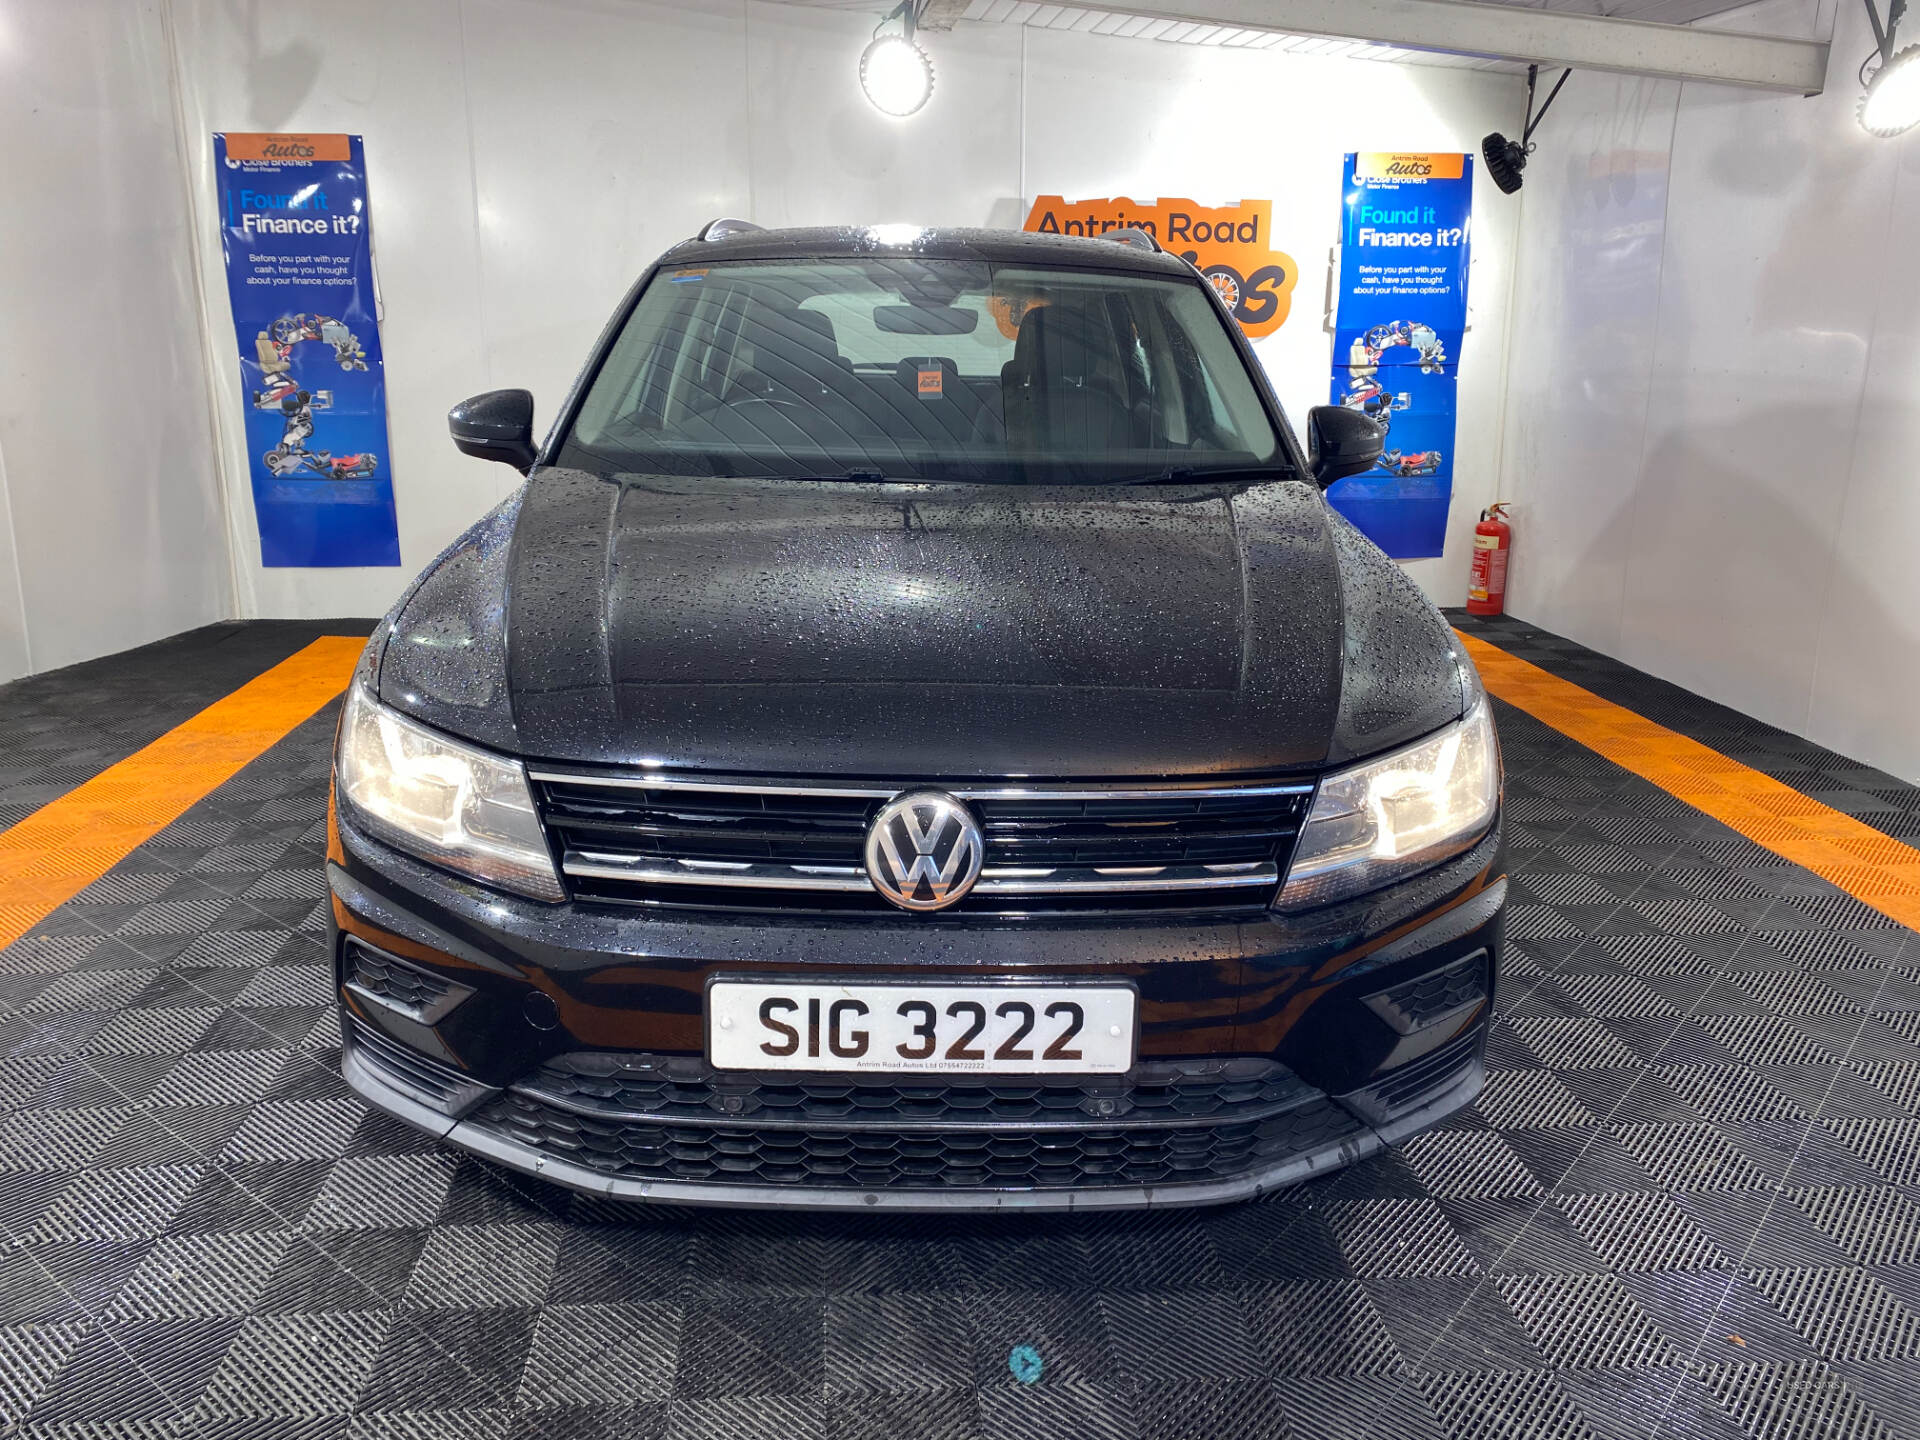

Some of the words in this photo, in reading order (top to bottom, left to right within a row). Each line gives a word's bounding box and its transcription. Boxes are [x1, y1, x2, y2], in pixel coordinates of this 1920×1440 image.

[262, 143, 315, 157] Autos
[1386, 162, 1432, 175] Autos
[313, 192, 328, 209] it
[1360, 206, 1418, 224] Found
[1423, 206, 1436, 224] it
[242, 213, 328, 233] Finance
[332, 215, 360, 234] it?
[1038, 211, 1157, 238] Antrim
[1168, 212, 1258, 243] Road
[1359, 228, 1432, 246] Finance
[1436, 228, 1462, 246] it?
[249, 254, 276, 262] Before
[278, 255, 294, 264] you
[296, 254, 312, 264] part
[313, 255, 330, 263] with
[332, 256, 350, 264] your
[254, 266, 277, 274] cash,
[300, 267, 315, 275] you
[317, 266, 348, 275] thought
[1384, 266, 1397, 274] you
[1398, 266, 1413, 274] part
[1430, 266, 1447, 274] your
[247, 276, 270, 284] about
[272, 277, 290, 286] your
[292, 276, 321, 284] finance
[323, 277, 356, 286] options?
[1361, 276, 1381, 284] cash,
[1401, 277, 1414, 285] you
[1415, 276, 1443, 285] thought
[1353, 286, 1374, 294] about
[1375, 286, 1391, 295] your
[1392, 286, 1418, 294] finance
[1419, 286, 1450, 295] options?
[758, 997, 870, 1058] SIG
[896, 1001, 1084, 1060] 3222
[882, 1061, 901, 1069] Road
